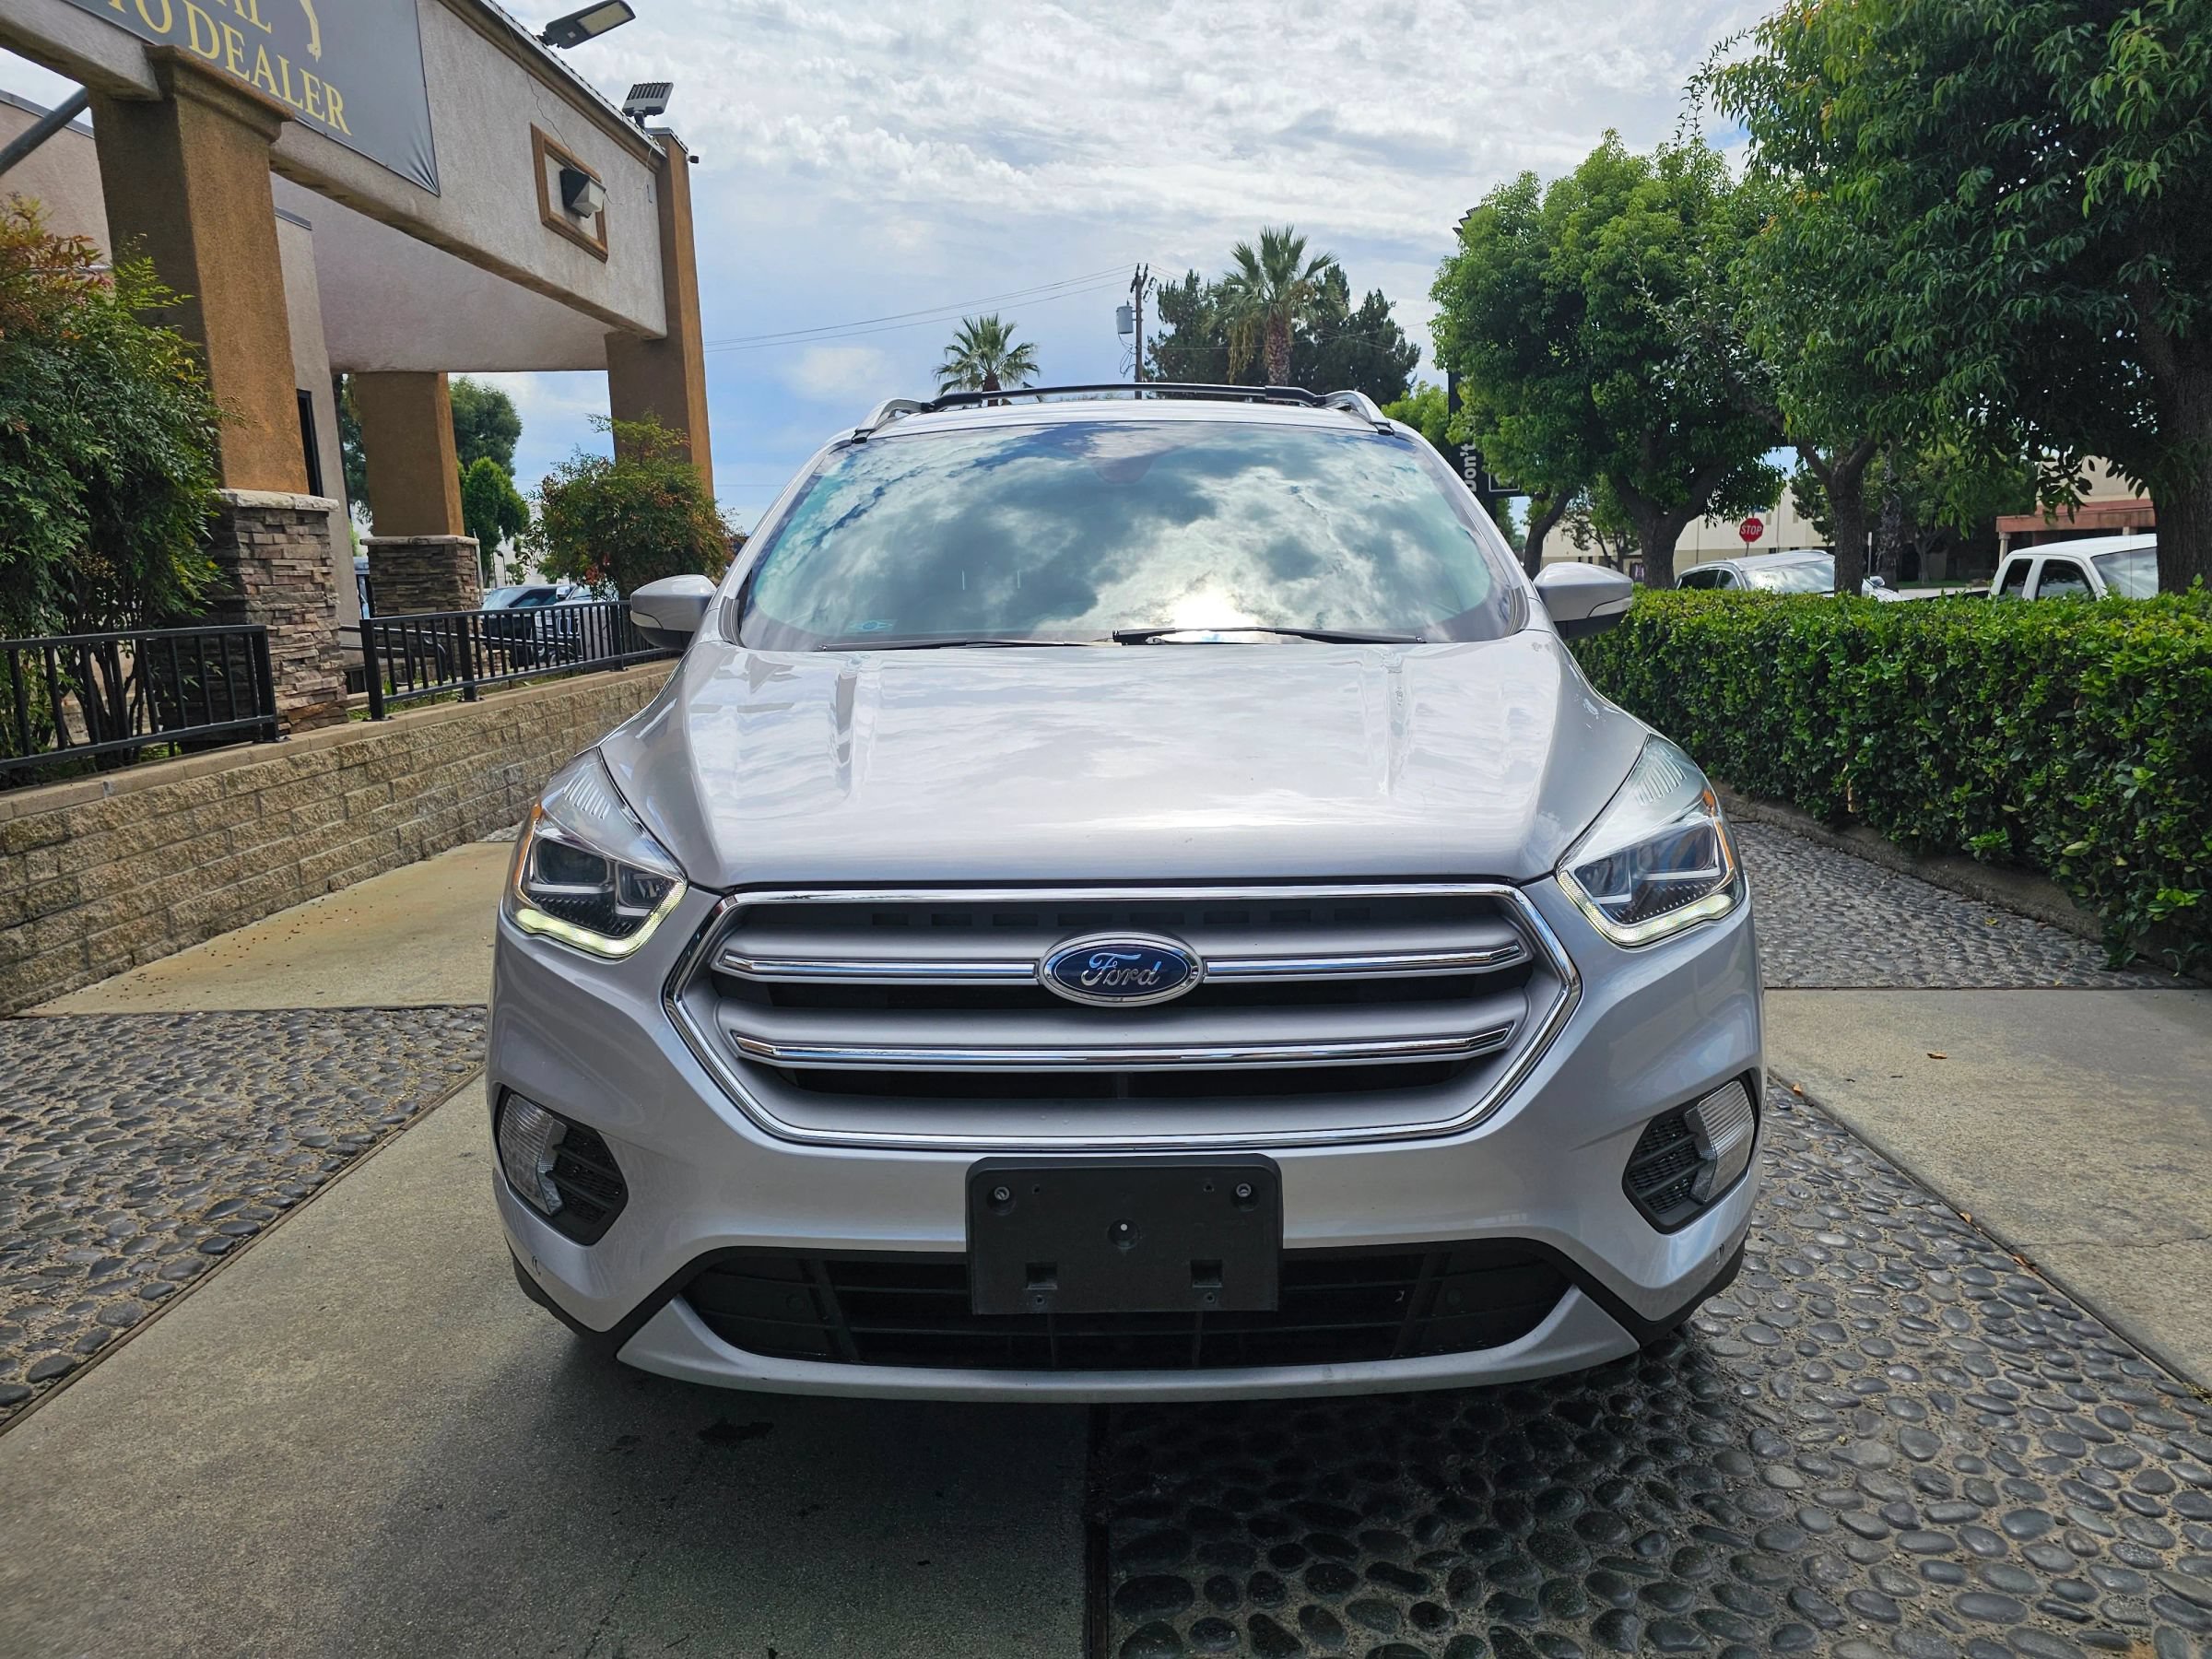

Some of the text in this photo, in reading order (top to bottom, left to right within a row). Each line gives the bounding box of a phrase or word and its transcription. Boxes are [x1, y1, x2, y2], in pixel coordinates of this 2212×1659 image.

[183, 0, 352, 136] DEALER
[1741, 525, 1762, 535] STOP
[1081, 952, 1162, 986] Ford
